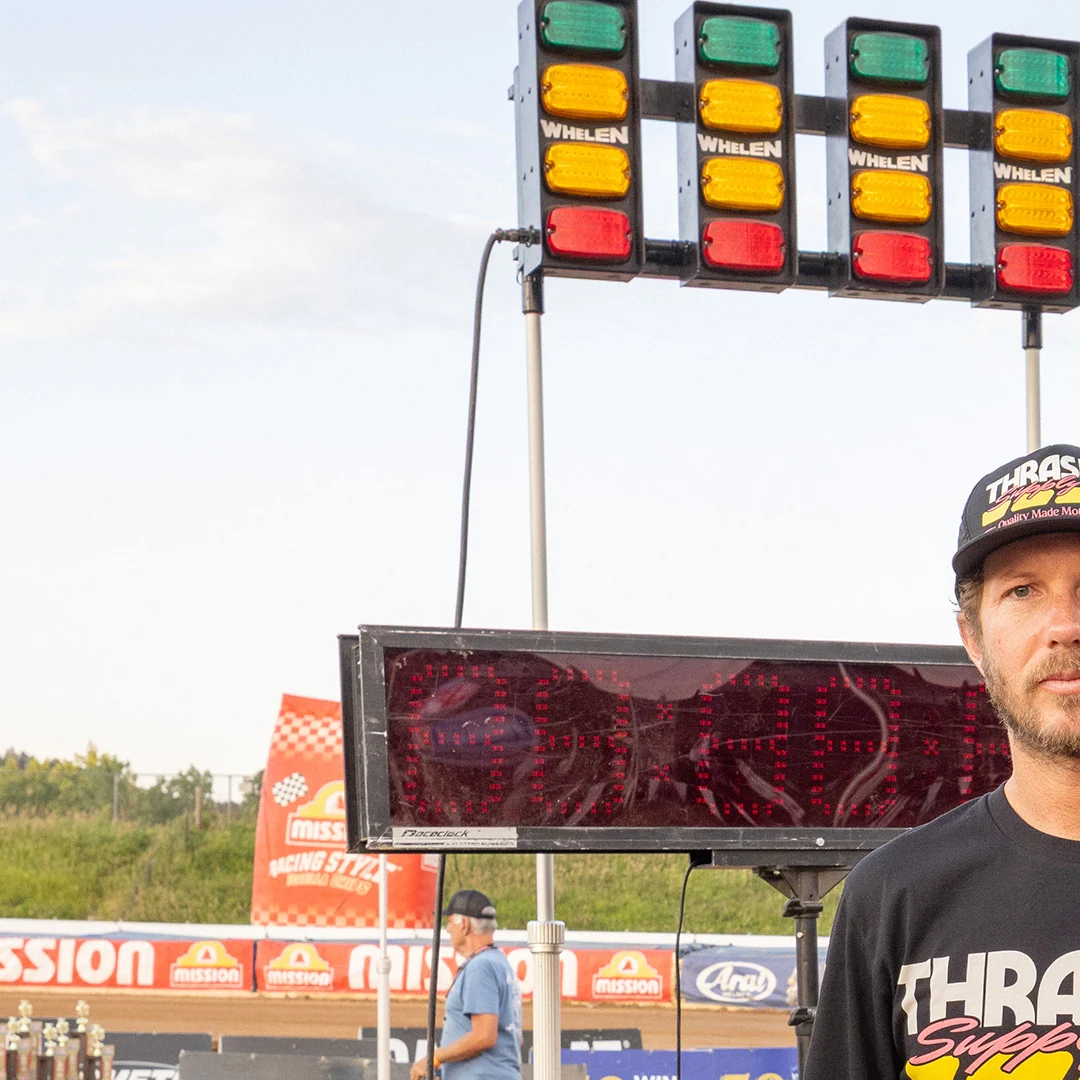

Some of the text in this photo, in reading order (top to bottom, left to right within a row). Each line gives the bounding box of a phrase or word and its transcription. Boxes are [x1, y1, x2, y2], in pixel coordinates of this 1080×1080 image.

[540, 119, 629, 145] WHELEN
[698, 132, 783, 158] WHELEN
[848, 147, 930, 172] WHELEN
[993, 161, 1073, 185] WHELEN
[997, 512, 1030, 529] Quality
[1031, 506, 1059, 519] Made
[291, 819, 346, 841] MISS
[0, 938, 155, 986] SSION
